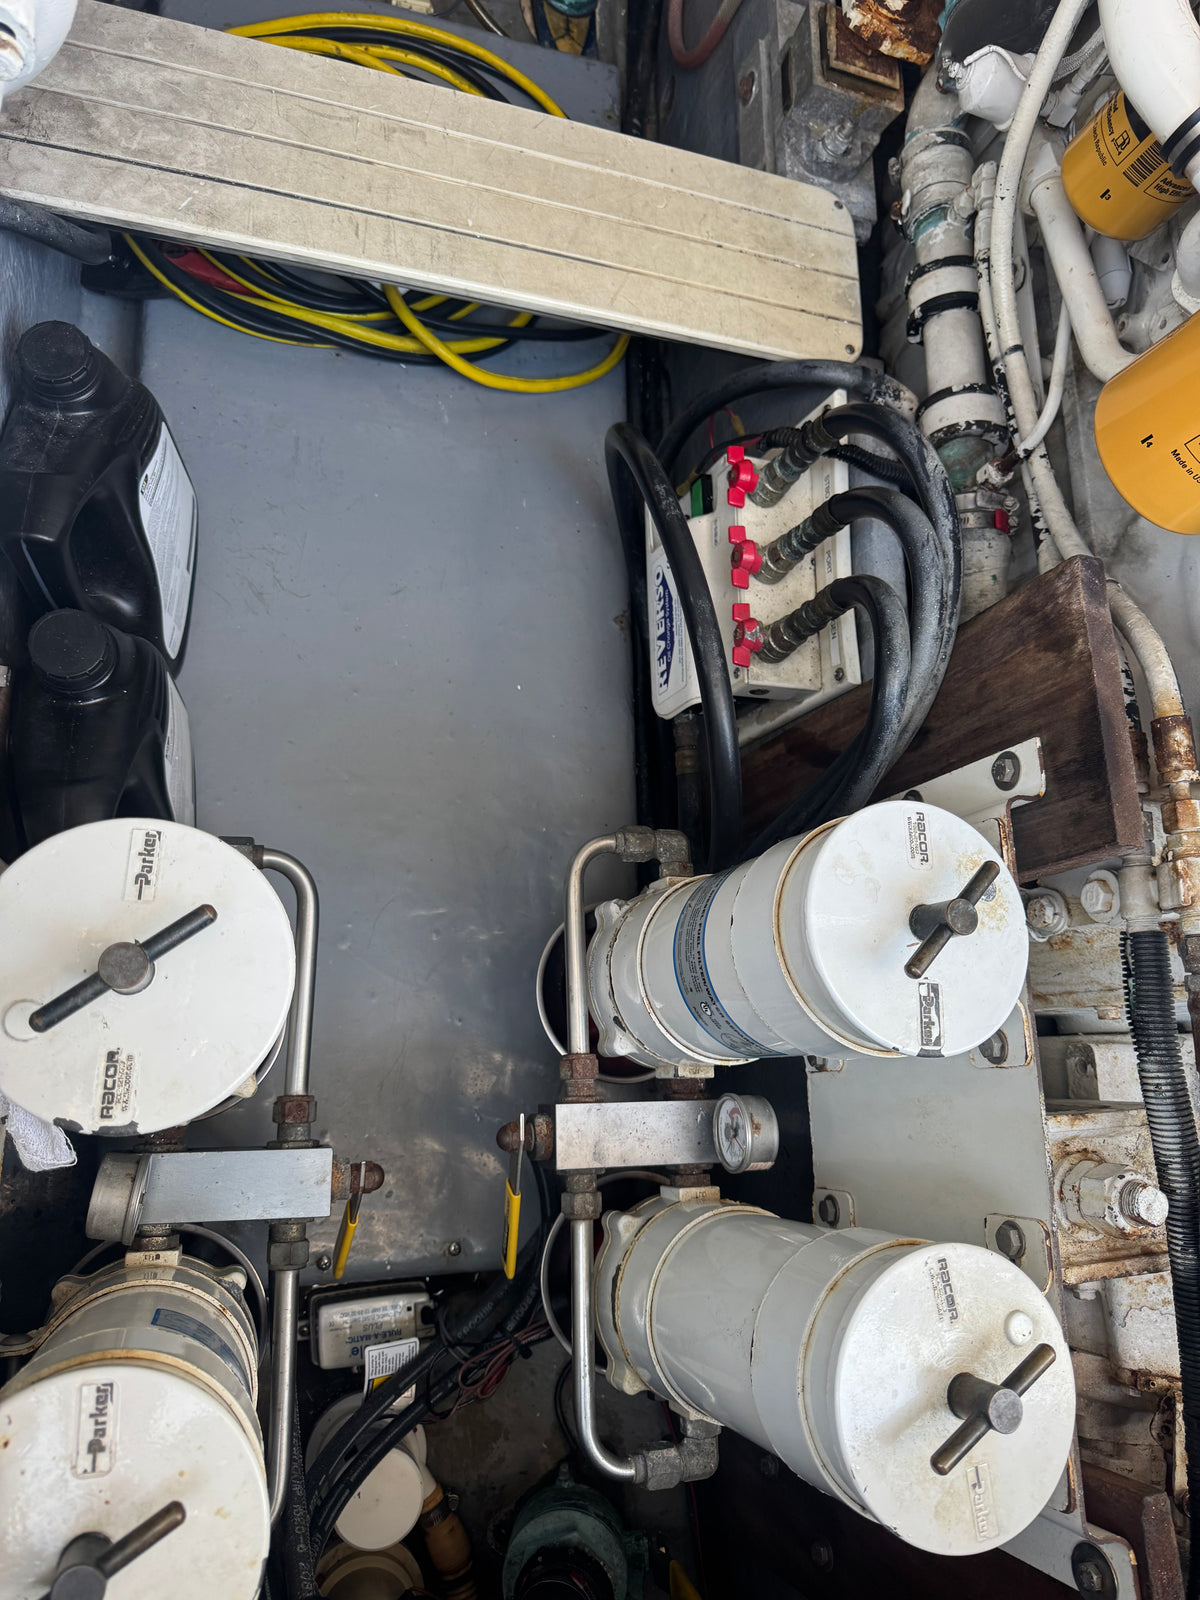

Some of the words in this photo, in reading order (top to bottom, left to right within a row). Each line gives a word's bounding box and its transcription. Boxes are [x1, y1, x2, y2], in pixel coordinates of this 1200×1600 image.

[1153, 183, 1170, 196] High
[1170, 449, 1188, 469] Made
[1185, 467, 1194, 476] in
[824, 550, 833, 575] PORT
[654, 564, 669, 696] REVERSO
[134, 831, 157, 886] Parker
[922, 994, 936, 1045] Parker
[362, 1321, 384, 1332] PLUS
[86, 1386, 109, 1454] Parker
